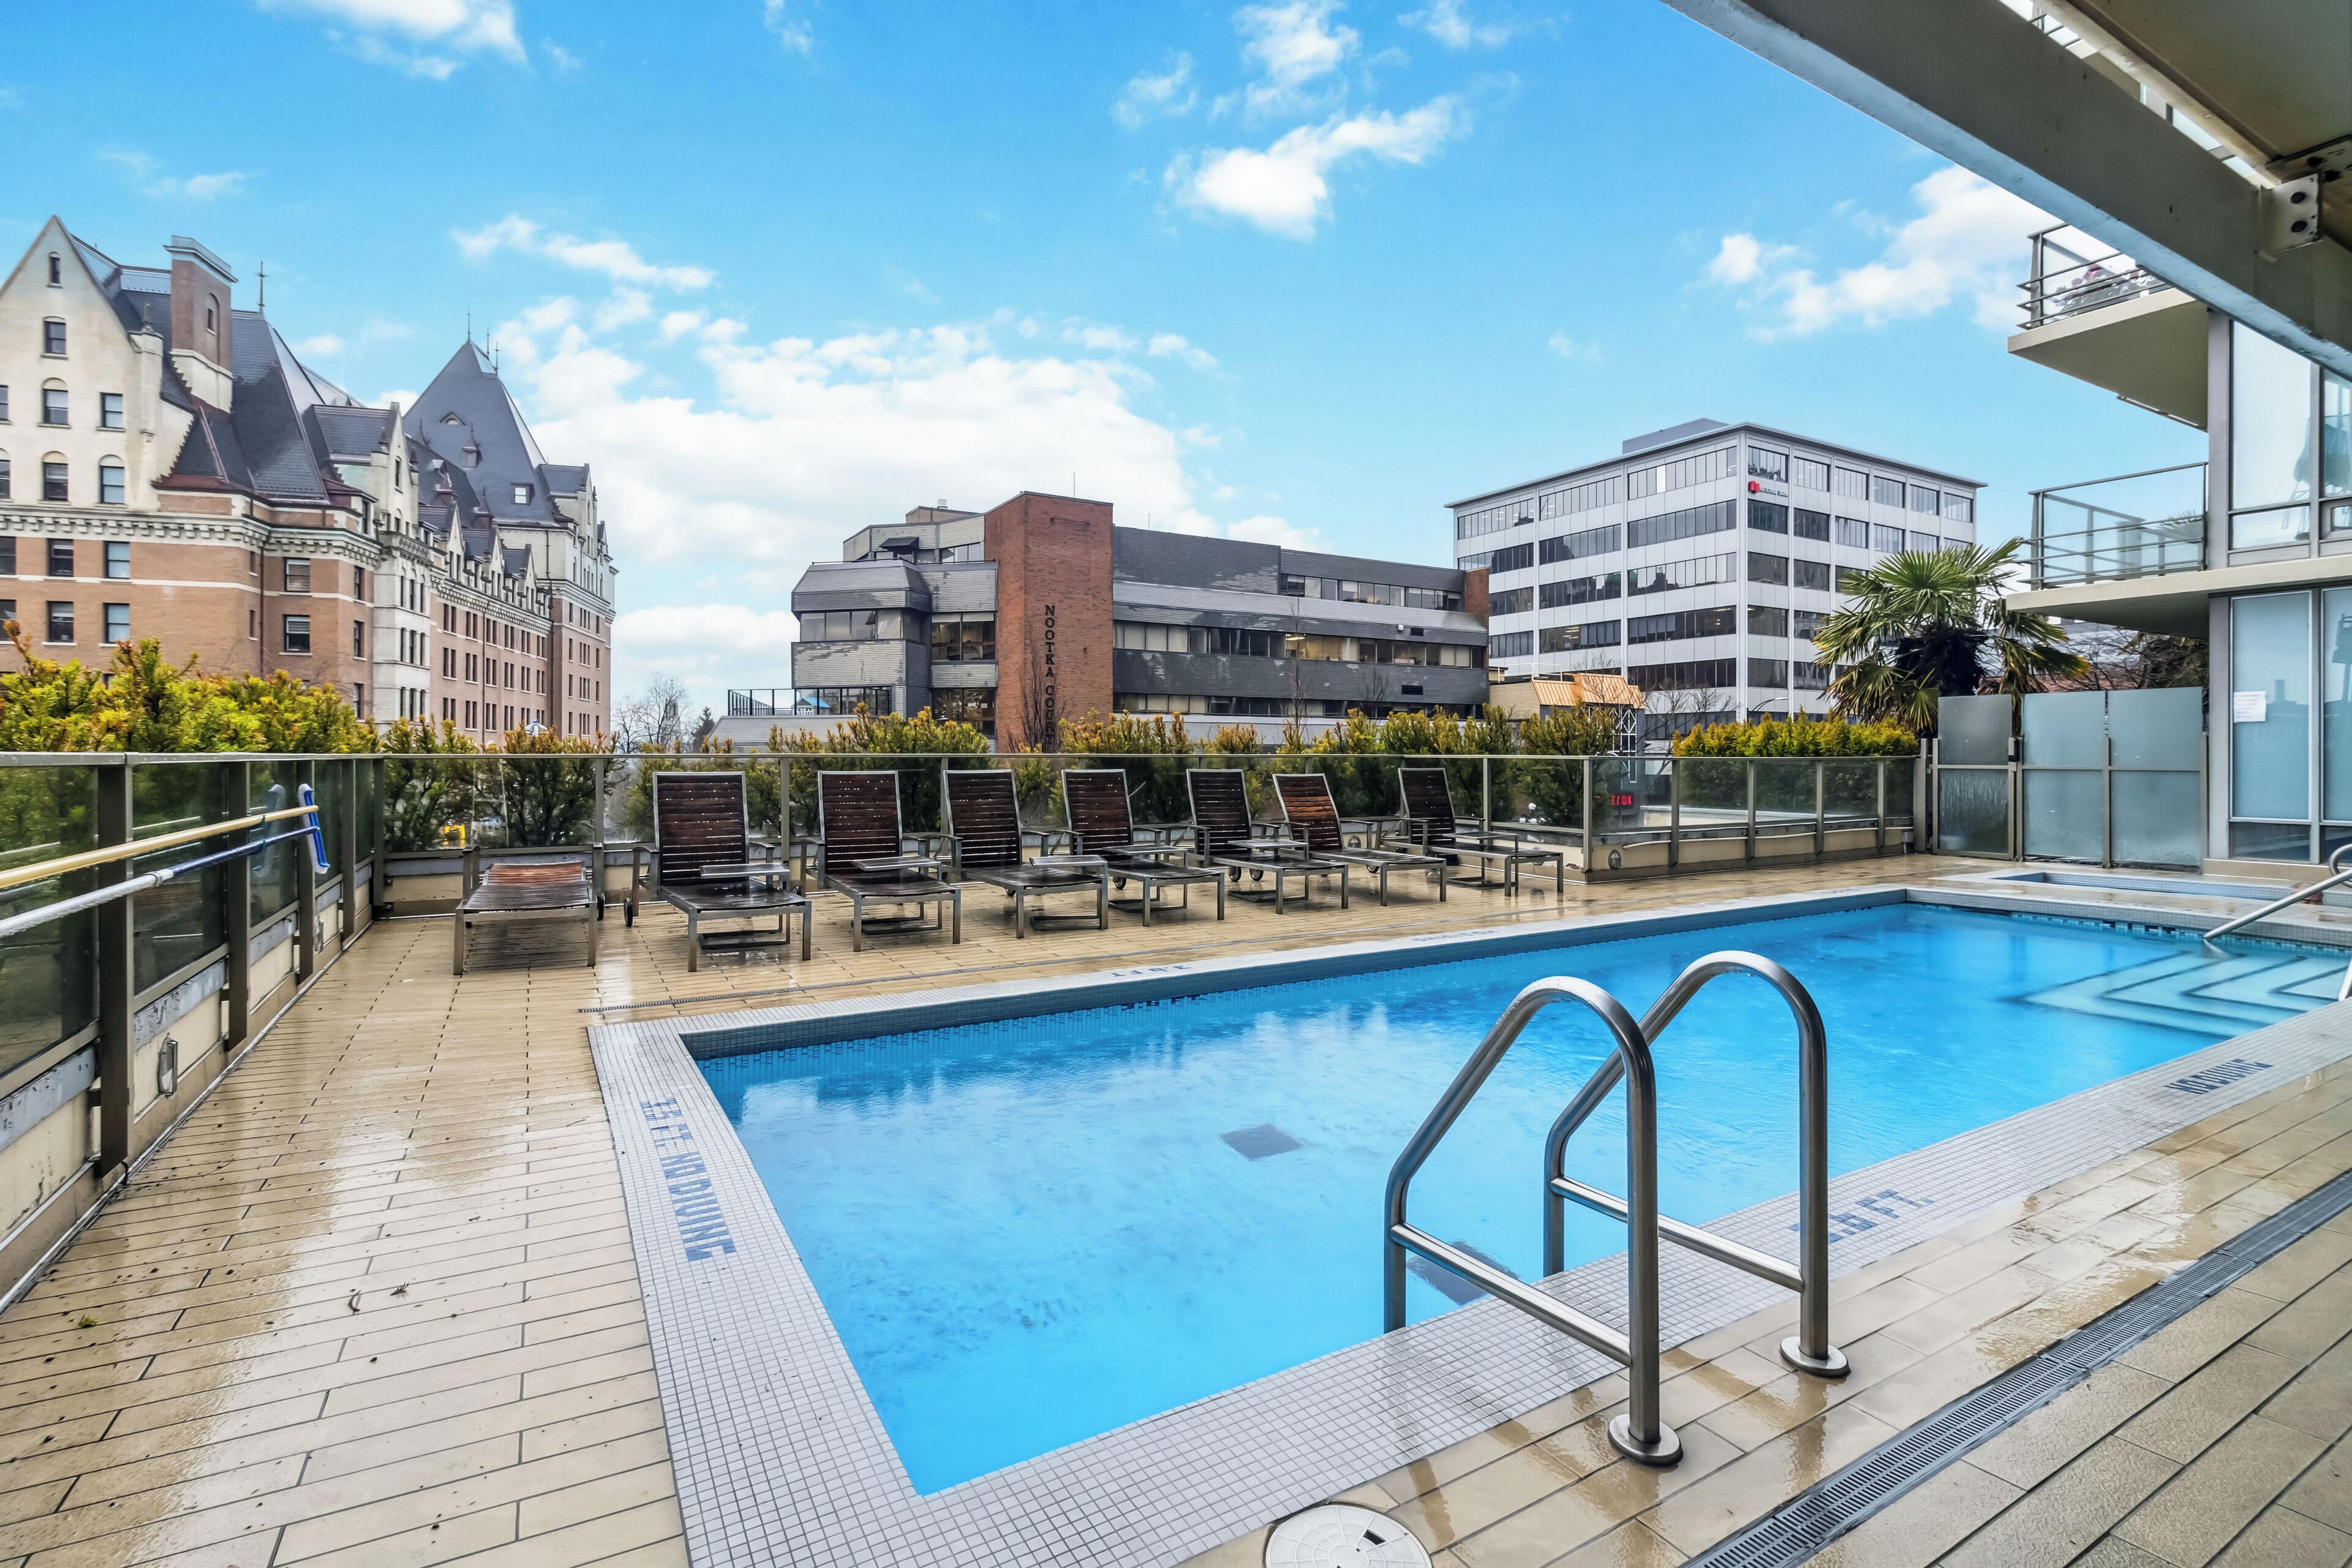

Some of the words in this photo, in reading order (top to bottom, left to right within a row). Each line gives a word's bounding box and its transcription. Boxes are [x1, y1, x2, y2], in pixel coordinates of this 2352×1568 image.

[1045, 605, 1055, 677] NOOTKA
[2189, 1058, 2274, 1085] DIVING
[660, 1151, 707, 1180] NO
[668, 1178, 736, 1262] DIVING
